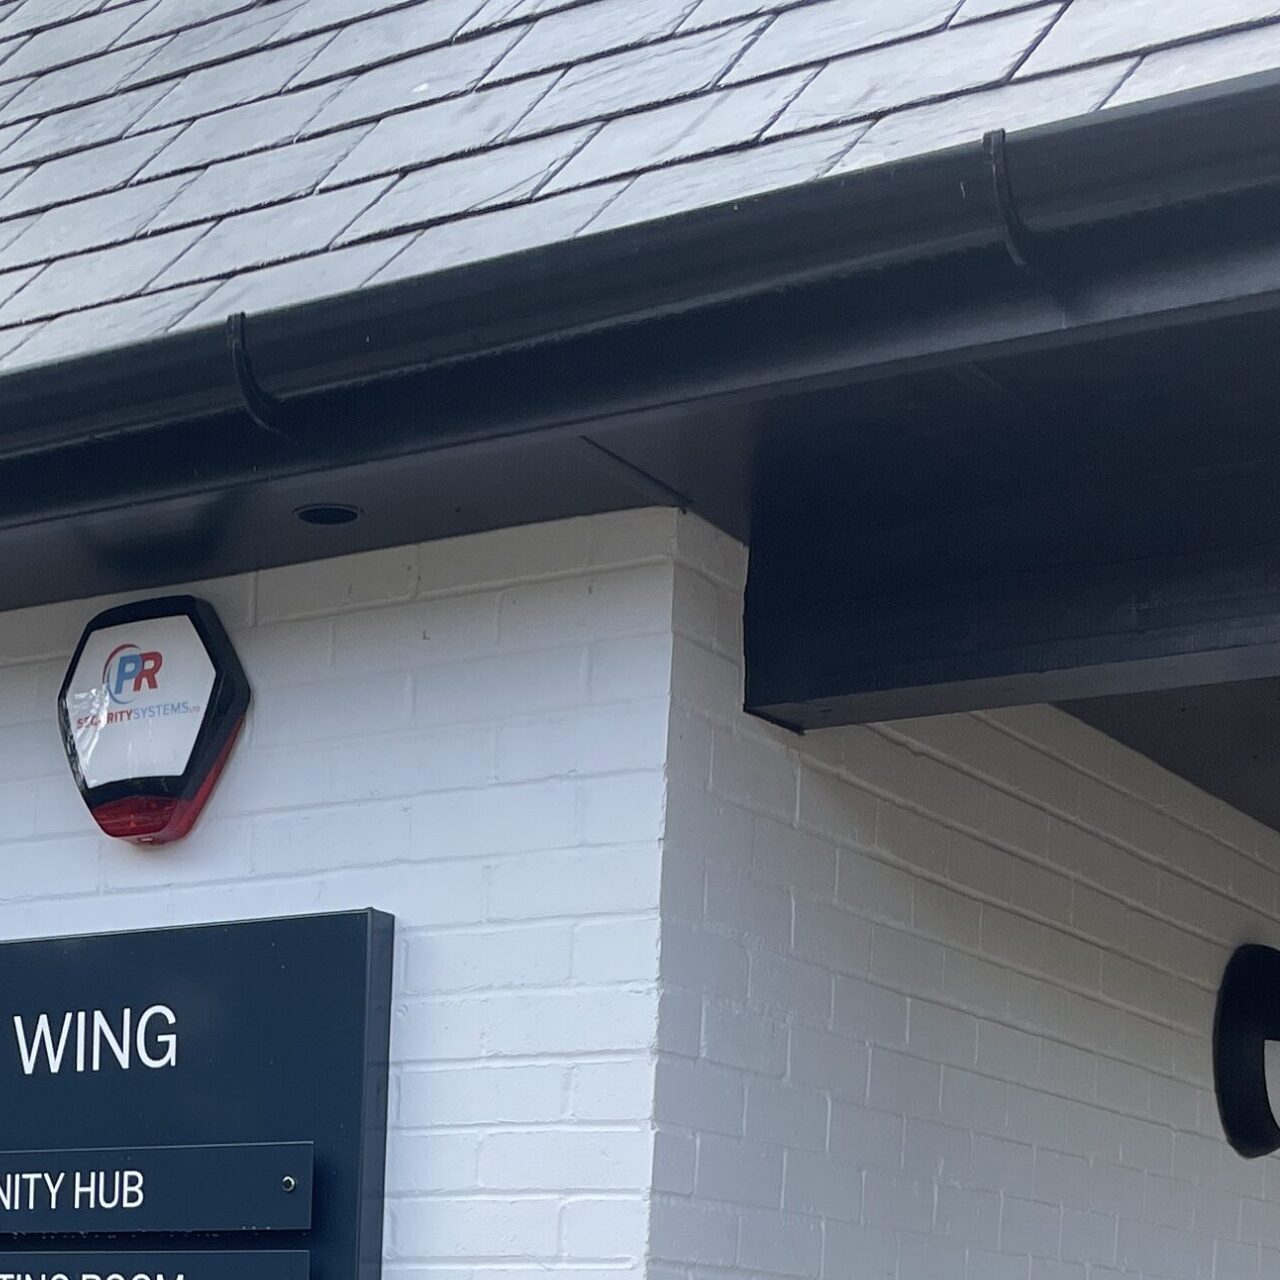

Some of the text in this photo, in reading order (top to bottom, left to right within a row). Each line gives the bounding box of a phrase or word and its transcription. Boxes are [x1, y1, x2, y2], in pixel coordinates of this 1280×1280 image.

[115, 651, 163, 694] PR
[13, 1004, 177, 1075] WING
[74, 1170, 144, 1209] HUB
